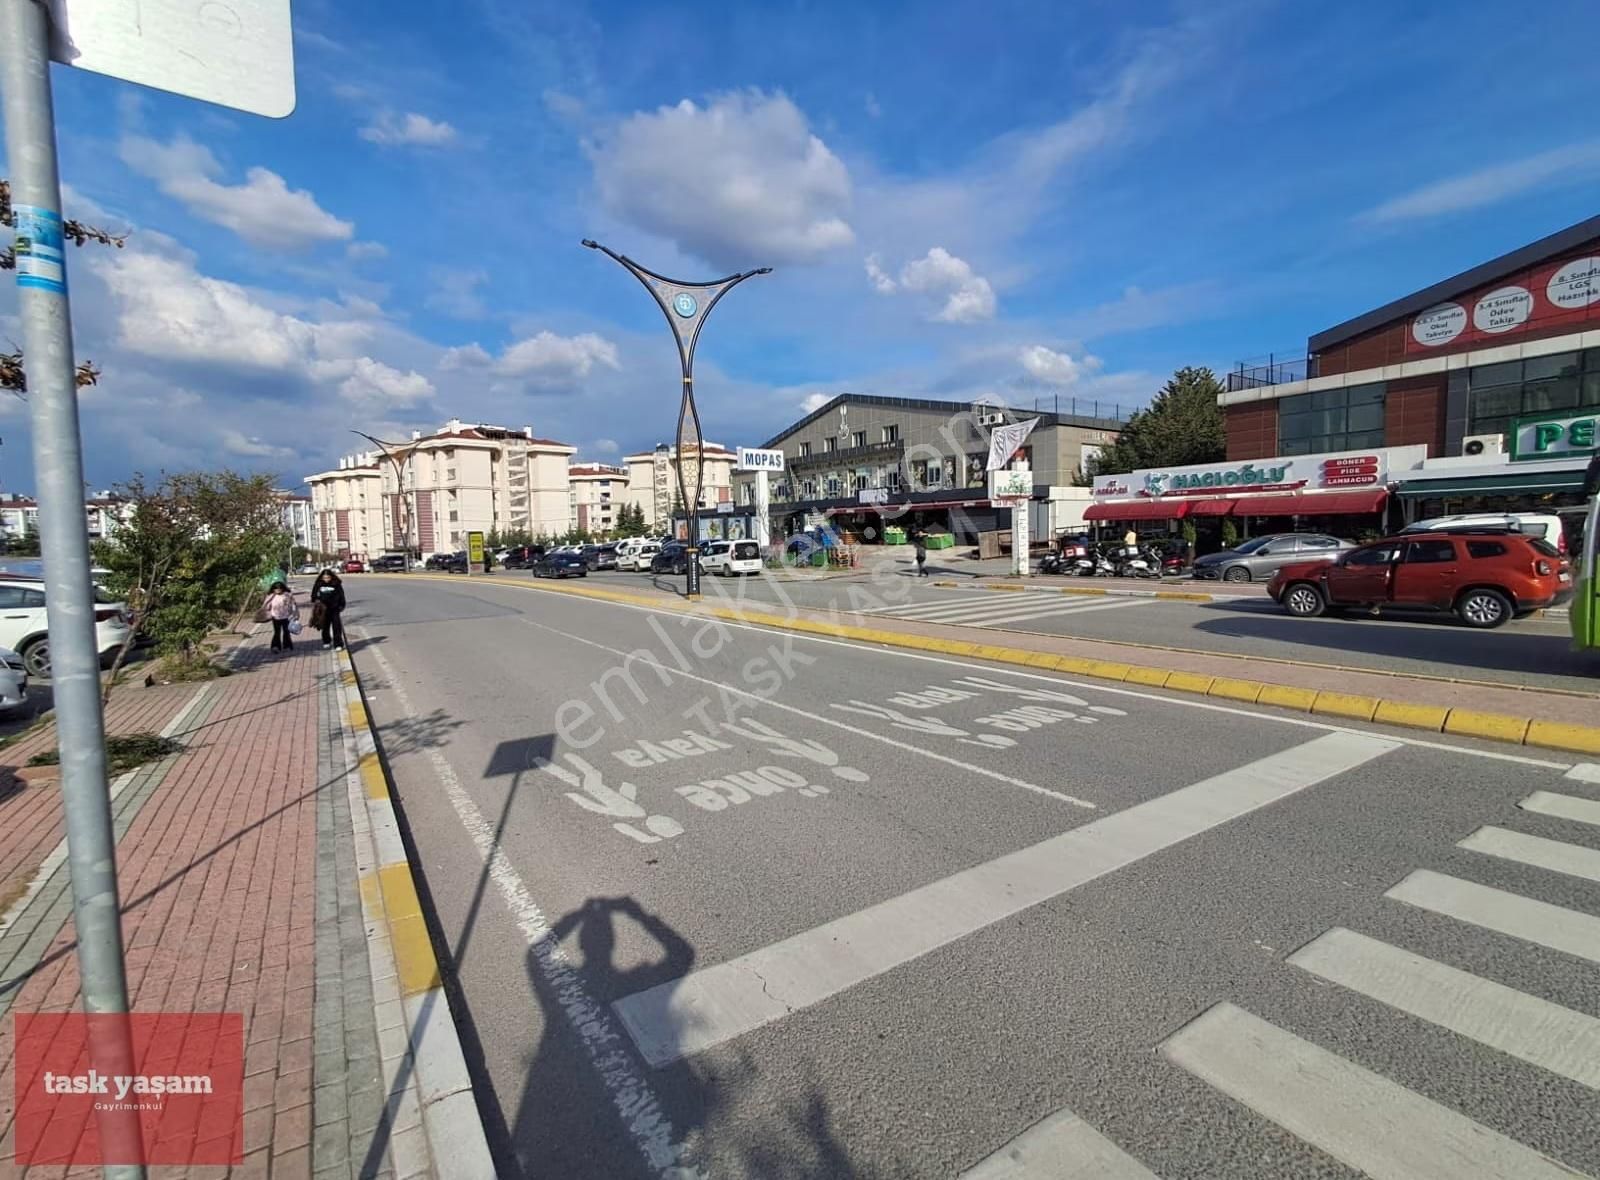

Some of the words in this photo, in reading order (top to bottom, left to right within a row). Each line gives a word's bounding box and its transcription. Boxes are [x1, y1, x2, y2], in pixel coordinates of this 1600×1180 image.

[1569, 278, 1591, 290] LGS
[1489, 316, 1515, 327] Takip
[1172, 463, 1286, 489] HACIOĞLU
